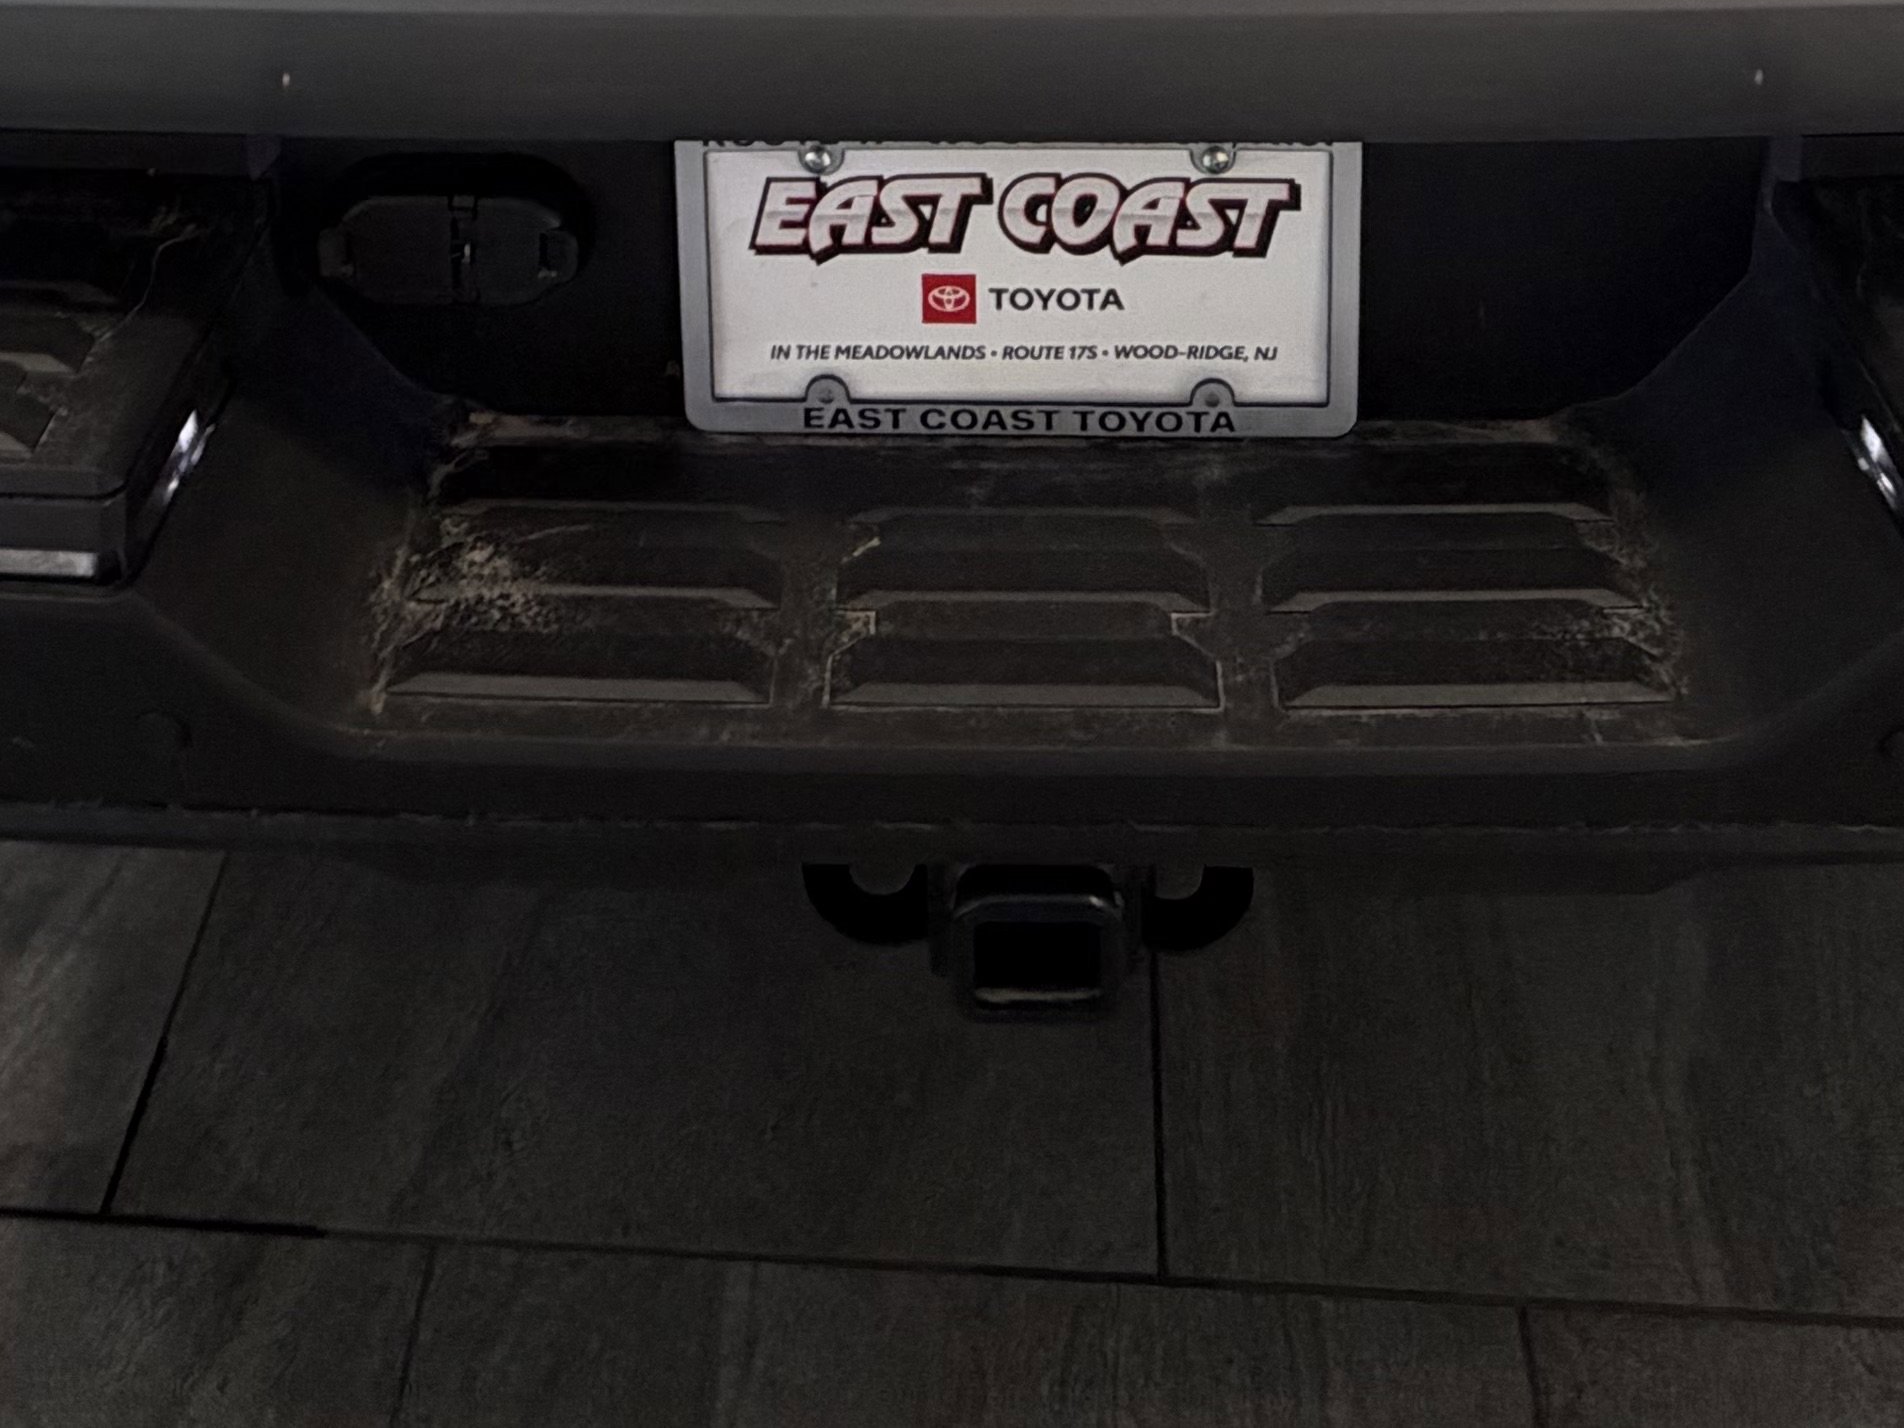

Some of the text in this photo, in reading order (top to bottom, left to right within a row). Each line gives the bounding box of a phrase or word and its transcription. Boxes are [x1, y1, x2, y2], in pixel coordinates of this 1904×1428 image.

[749, 172, 1303, 266] EAST COAST
[988, 286, 1125, 312] TOYOTA
[770, 344, 1278, 363] IN THE MEADOWLANDS ROUTE 17S WOOD-RIDGE, NJ
[803, 407, 1236, 433] EAST COAST TOYOTA
